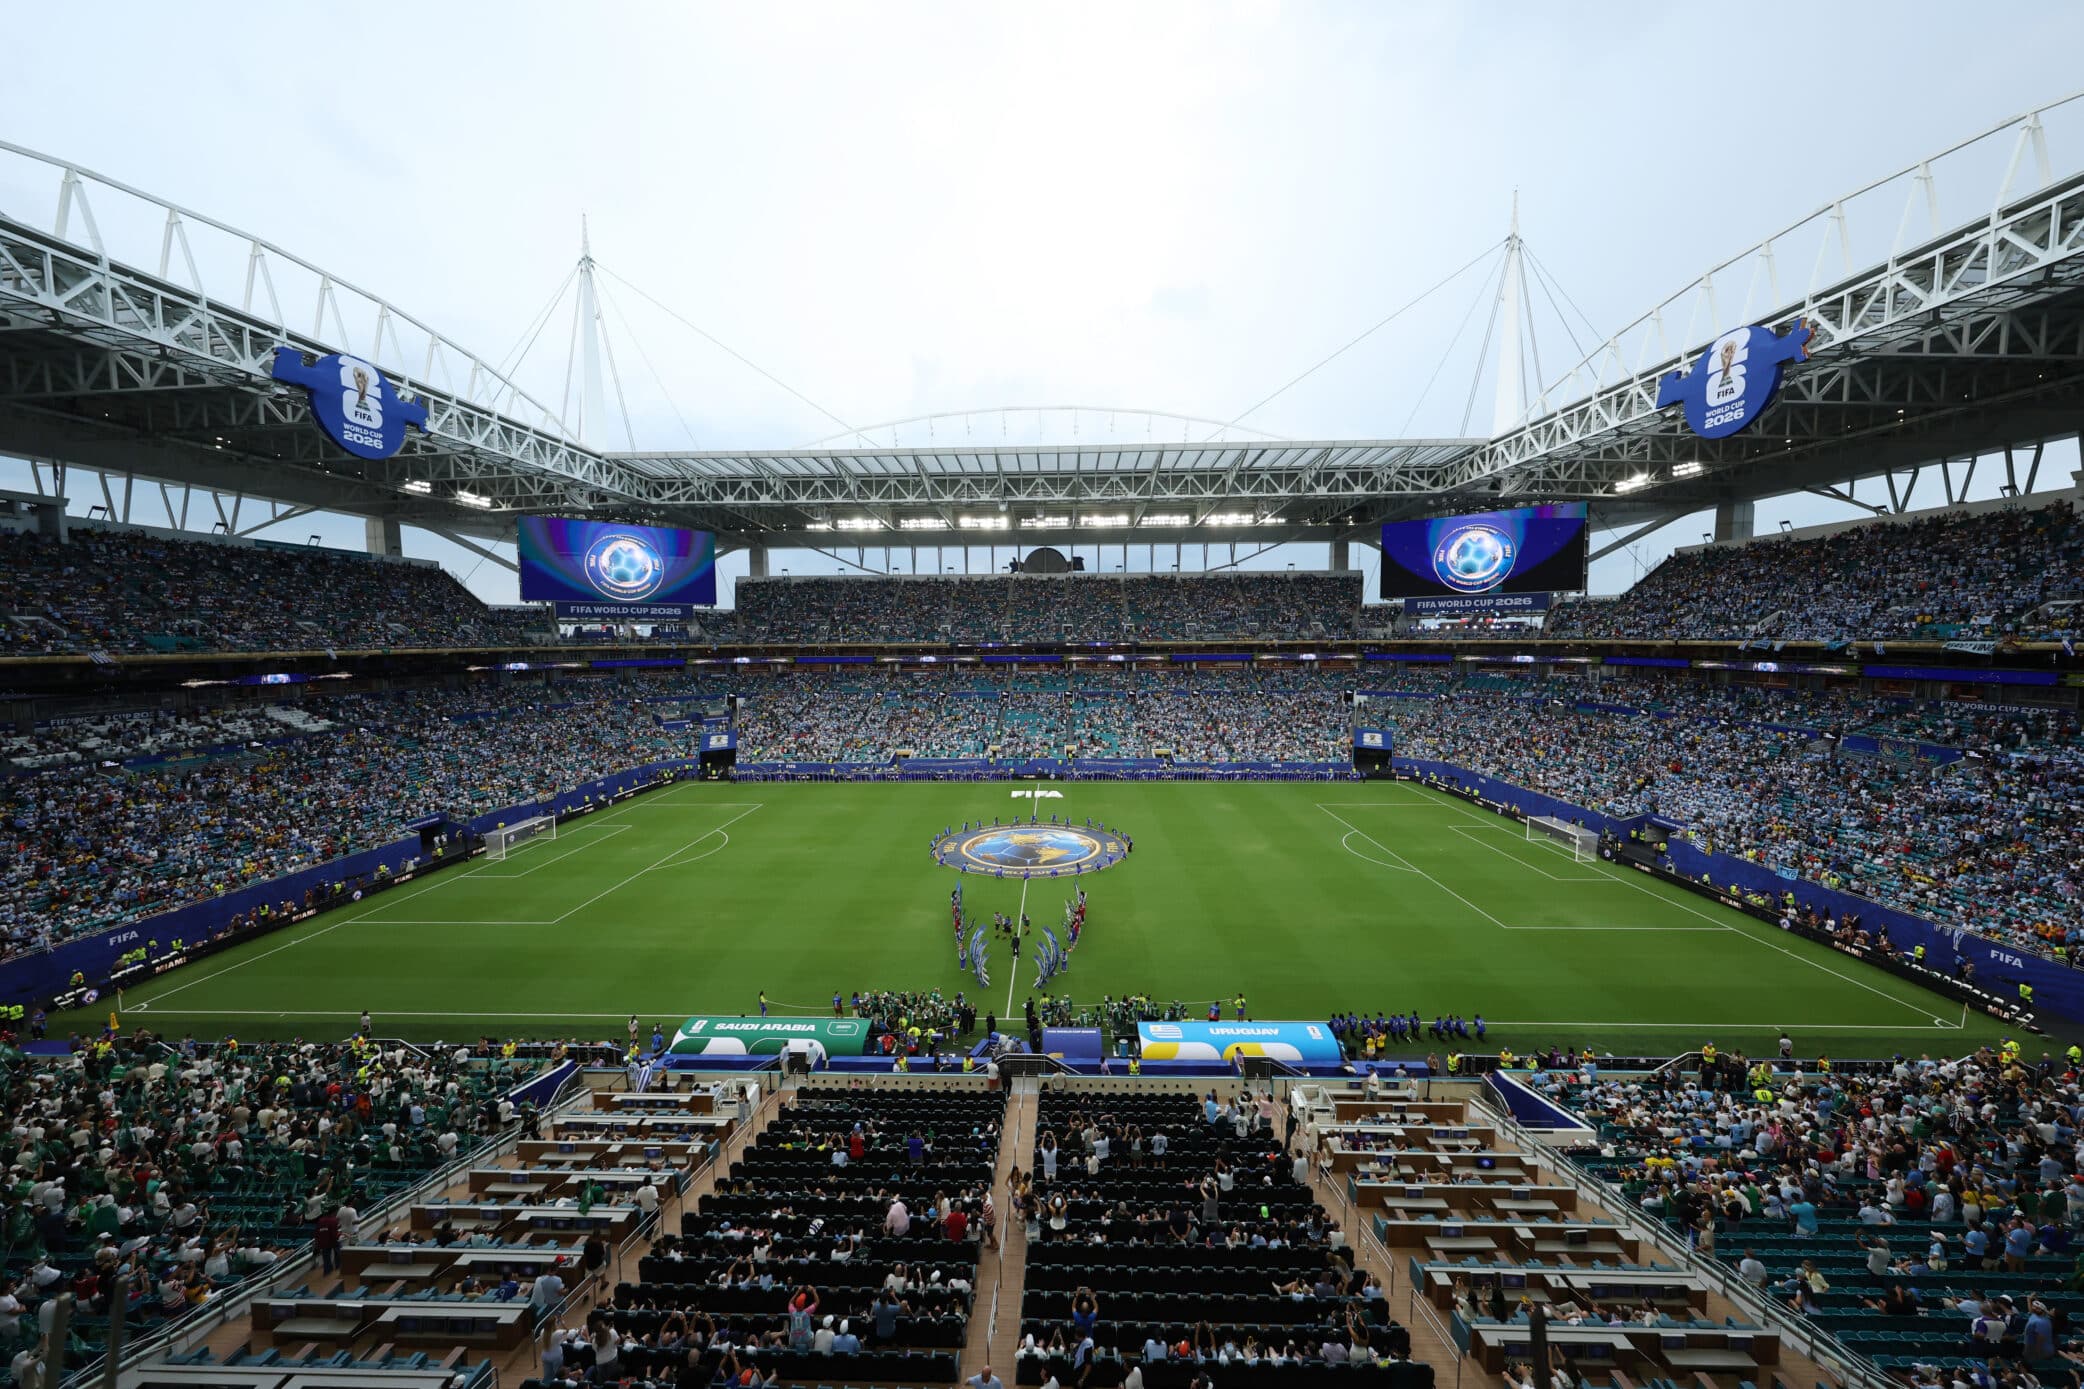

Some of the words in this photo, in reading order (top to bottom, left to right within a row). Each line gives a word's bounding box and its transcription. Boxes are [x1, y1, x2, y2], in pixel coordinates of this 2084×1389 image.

[1717, 387, 1735, 399] FIFA
[1705, 404, 1730, 418] WORLD
[1731, 400, 1745, 411] CUP
[354, 410, 373, 423] FIFA
[1704, 408, 1745, 429] 2026
[343, 423, 369, 436] WORLD
[369, 430, 383, 439] CUP
[343, 430, 384, 449] 2026
[1417, 601, 1436, 609] FIFA
[1438, 600, 1472, 608] WORLD
[1495, 597, 1532, 606] 2026
[570, 606, 592, 614] FIFA
[593, 606, 629, 614] WORLD
[650, 607, 682, 615] 2026
[1998, 705, 2020, 713] CUP
[1011, 790, 1064, 799] FIFA
[108, 930, 139, 946] FIFA
[1990, 949, 2024, 969] FIFA
[714, 1023, 759, 1031] SAUDI
[760, 1023, 816, 1032] ARABIA
[1208, 1027, 1280, 1036] URUGUAY
